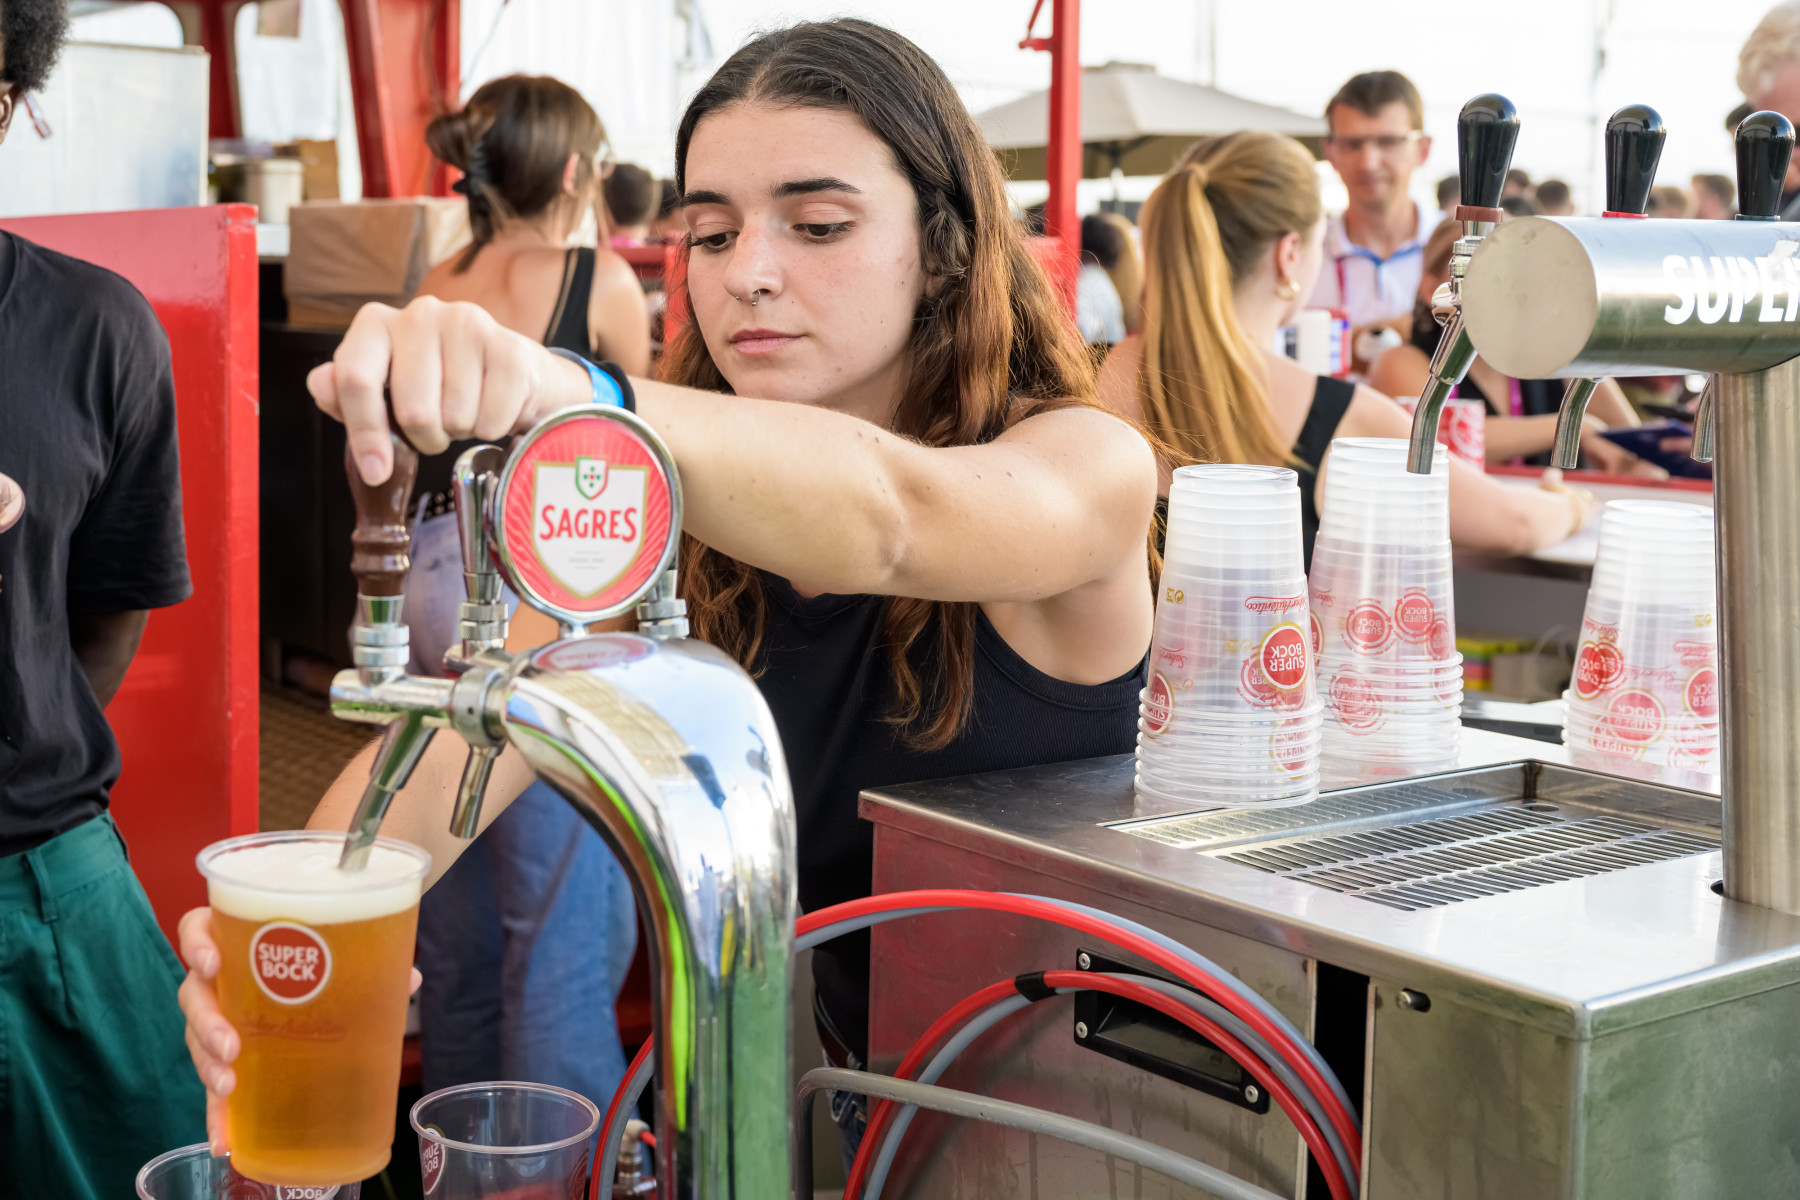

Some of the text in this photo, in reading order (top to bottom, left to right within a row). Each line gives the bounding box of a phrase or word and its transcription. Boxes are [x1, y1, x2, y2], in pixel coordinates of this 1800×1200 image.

[540, 505, 637, 542] SAGRES
[1270, 643, 1302, 659] BOCK
[1269, 655, 1305, 672] SUPER
[1694, 684, 1714, 695] OCK
[258, 943, 319, 964] SUPER
[262, 961, 316, 981] BOCK
